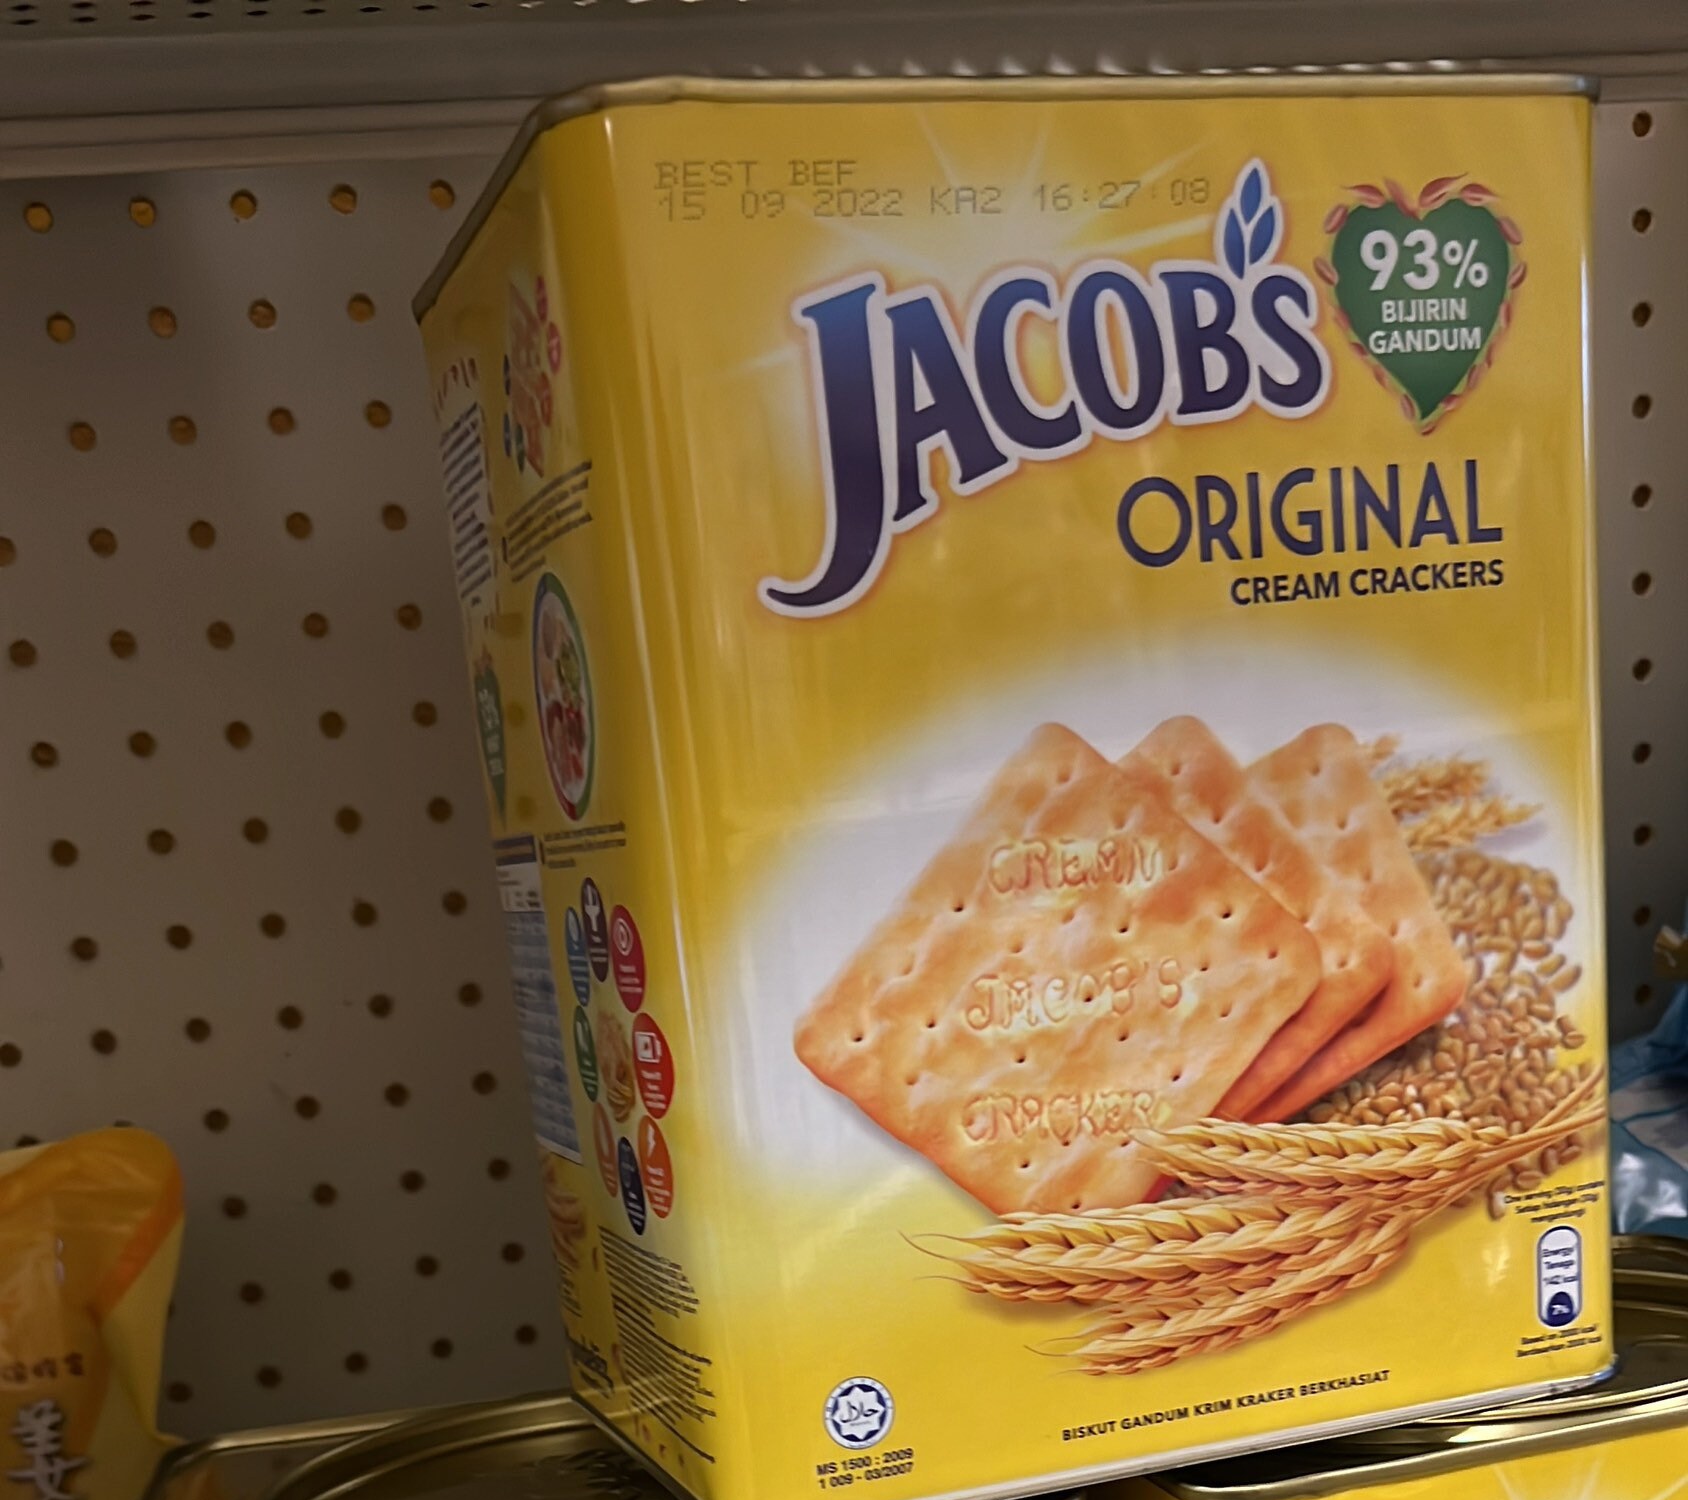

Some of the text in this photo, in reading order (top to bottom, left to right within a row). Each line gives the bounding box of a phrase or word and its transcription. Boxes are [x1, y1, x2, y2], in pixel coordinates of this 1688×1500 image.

[654, 159, 857, 190] BEST BEF
[658, 188, 706, 222] 15
[741, 189, 786, 219] 09
[813, 187, 904, 218] 2022
[1359, 229, 1489, 292] 93%
[1381, 297, 1468, 324] BIJIRIN
[1368, 327, 1482, 355] GANDUM
[1116, 459, 1504, 568] ORIGINAL
[1229, 558, 1505, 606] CREAM CRACKERS
[1062, 1369, 1390, 1441] BISKUT GANDUM KRIM KRAKER BERKHASIAT
